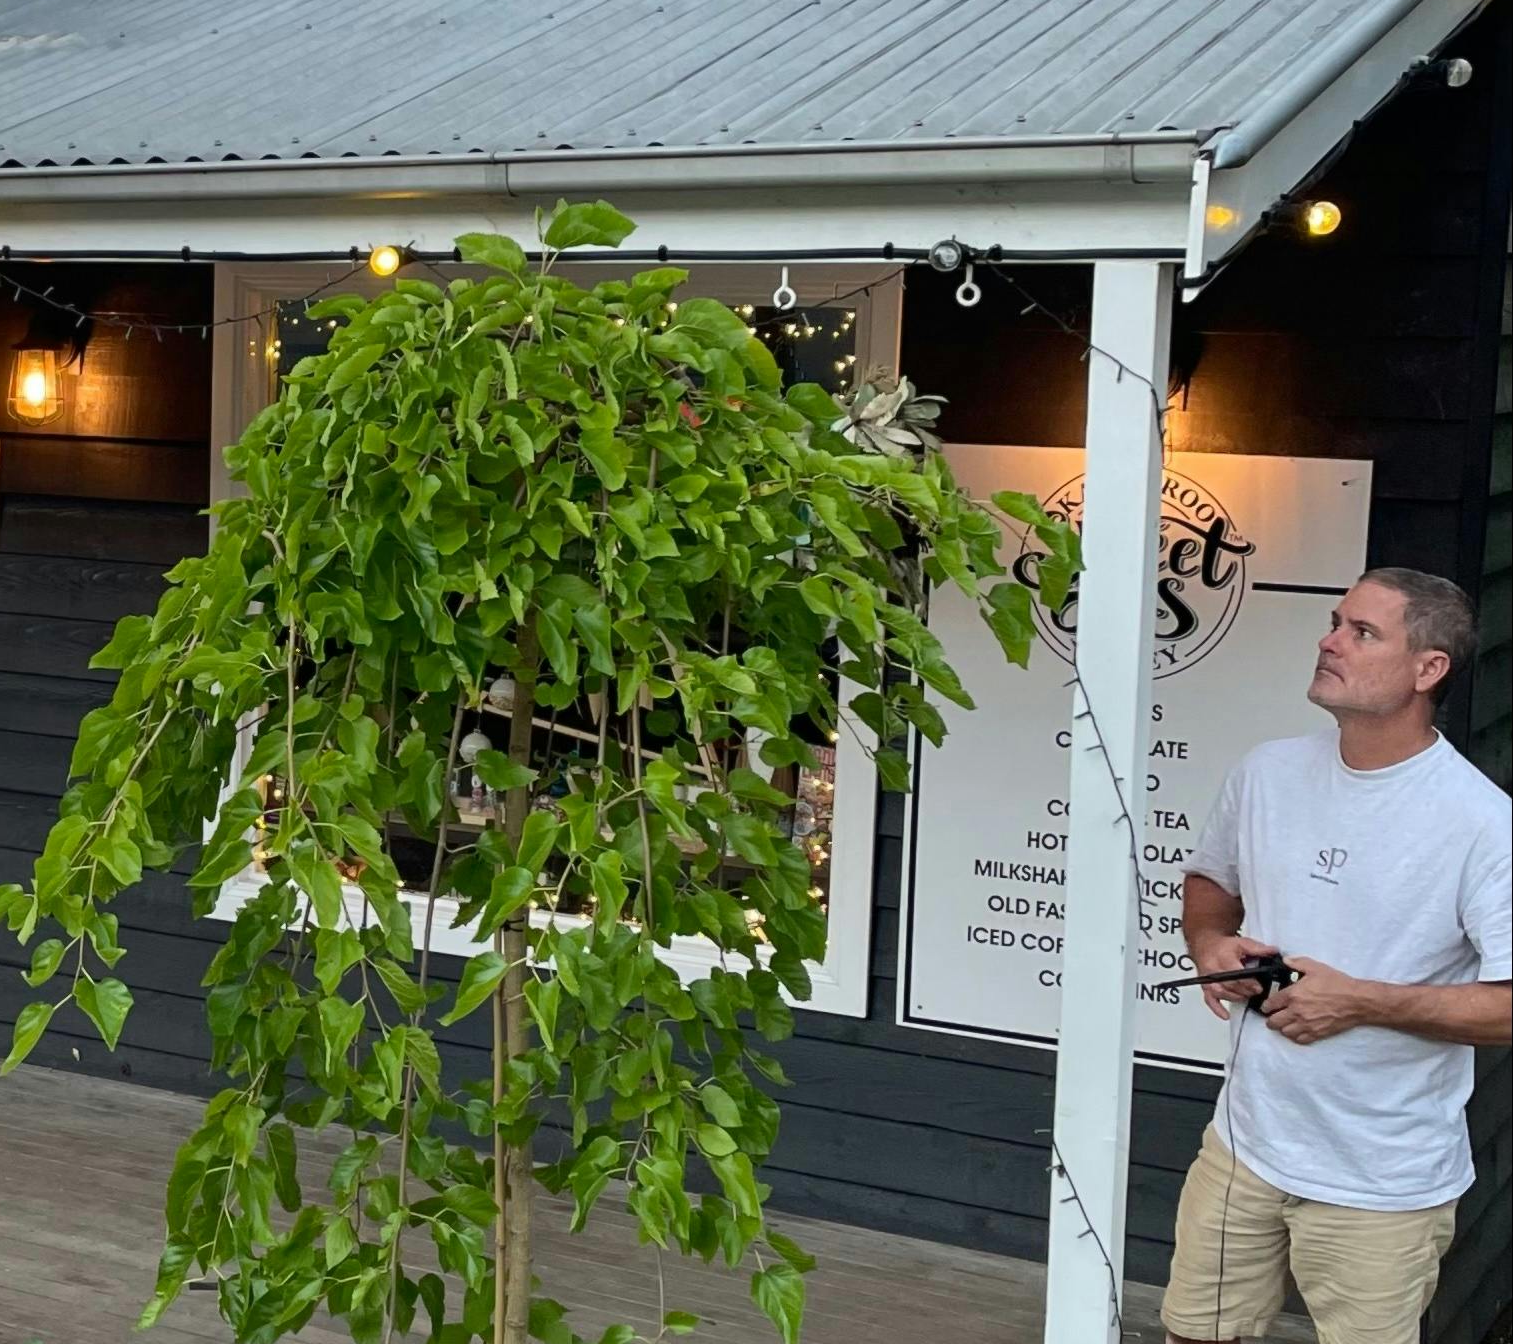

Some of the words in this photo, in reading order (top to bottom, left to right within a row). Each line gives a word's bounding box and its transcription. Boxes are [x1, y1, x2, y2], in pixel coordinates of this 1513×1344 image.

[1153, 810, 1190, 831] TEA
[1027, 831, 1069, 852] HOT
[987, 895, 1030, 916] OLD
[967, 925, 1015, 947] ICED
